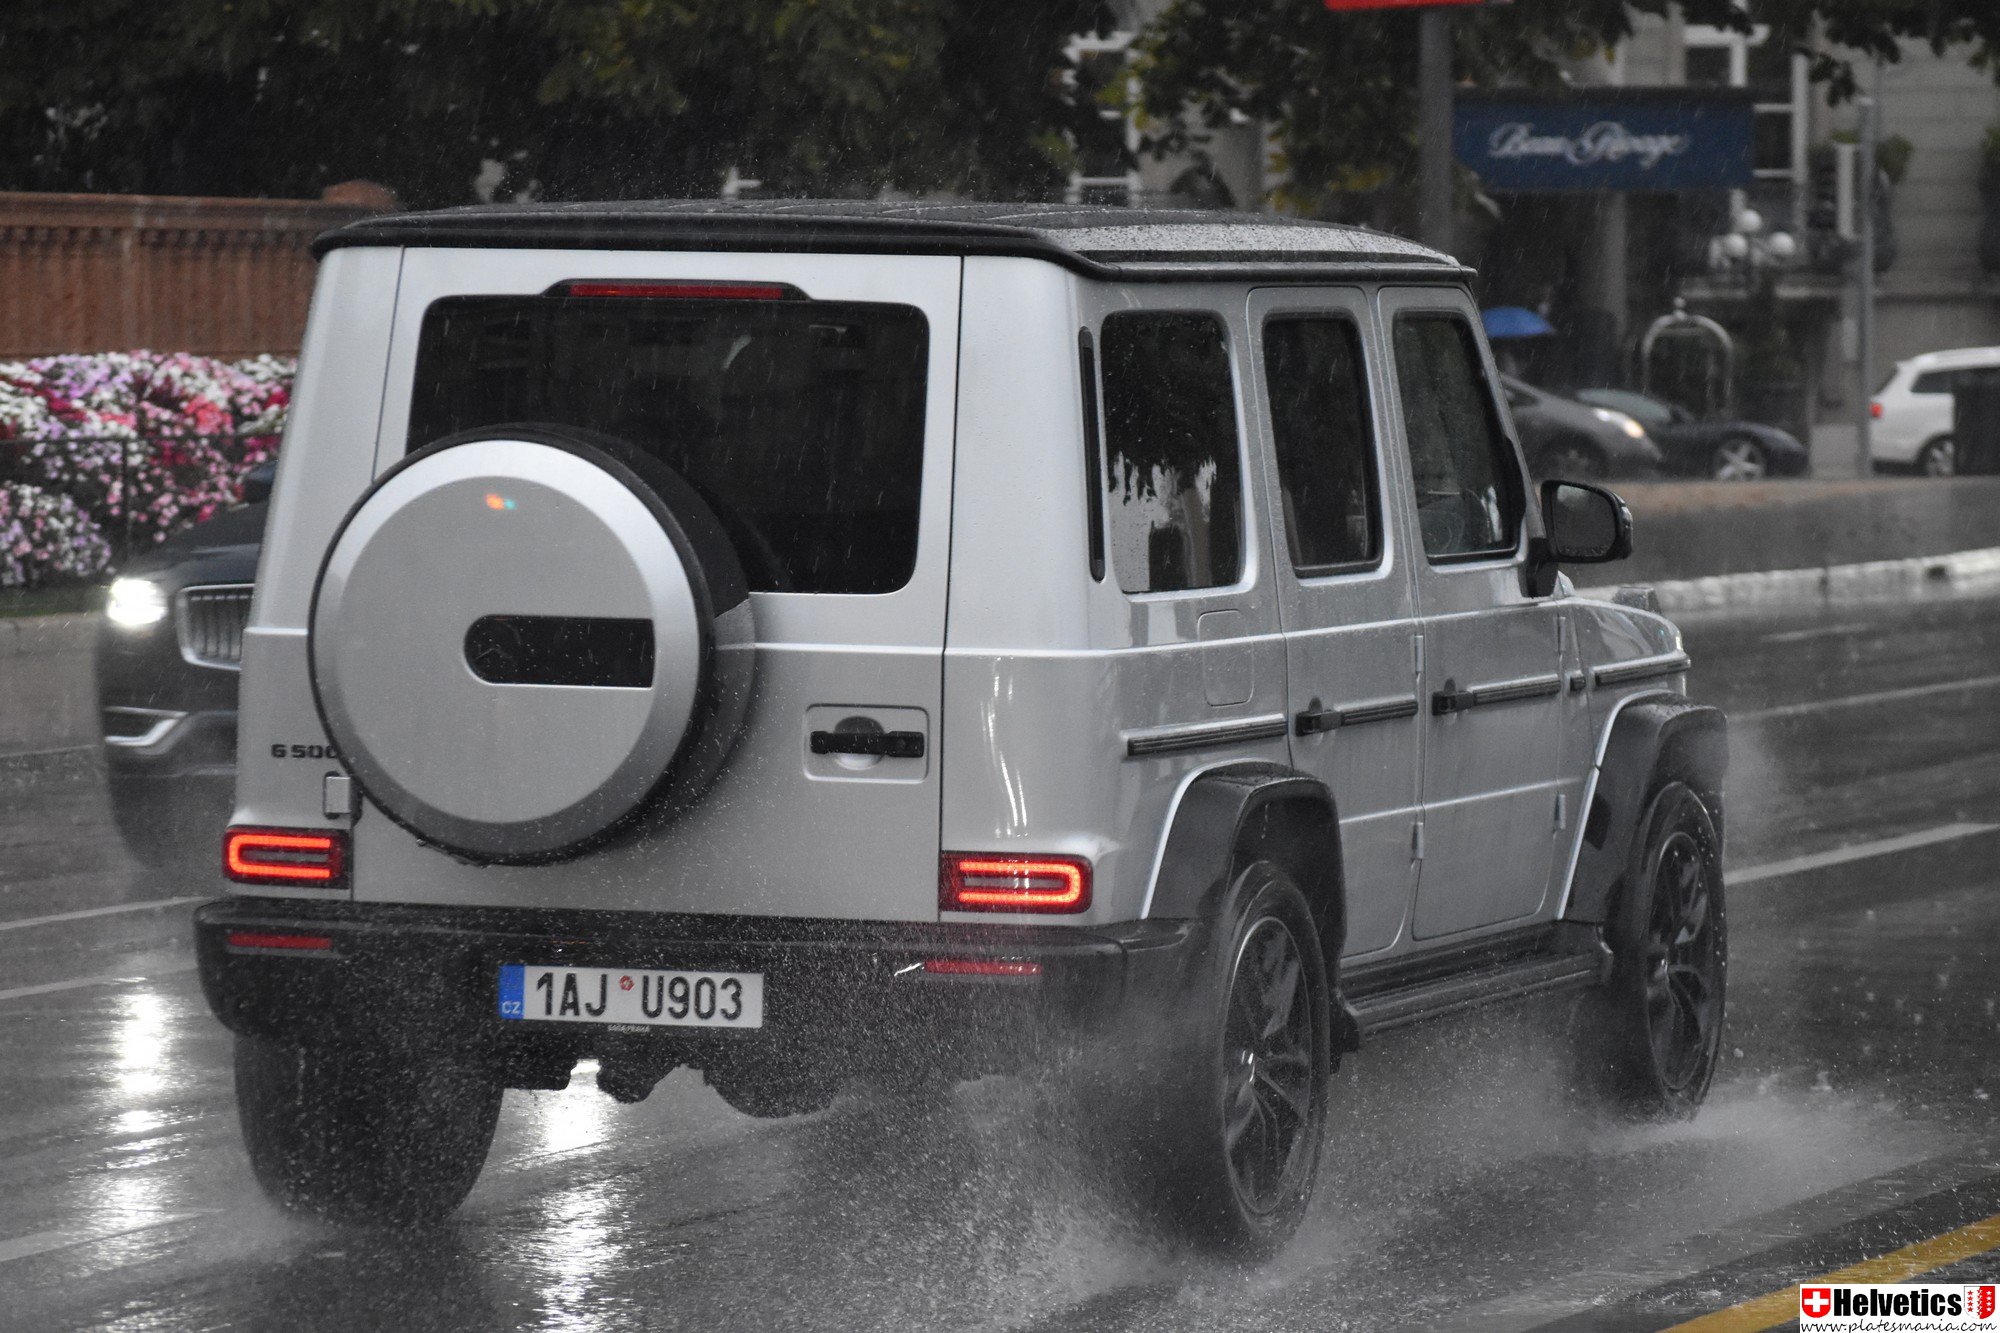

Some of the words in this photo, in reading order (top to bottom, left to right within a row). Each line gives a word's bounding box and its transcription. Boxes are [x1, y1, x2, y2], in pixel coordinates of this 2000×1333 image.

[502, 1001, 520, 1014] CZ
[537, 972, 608, 1016] 1AJ
[642, 975, 742, 1020] U903
